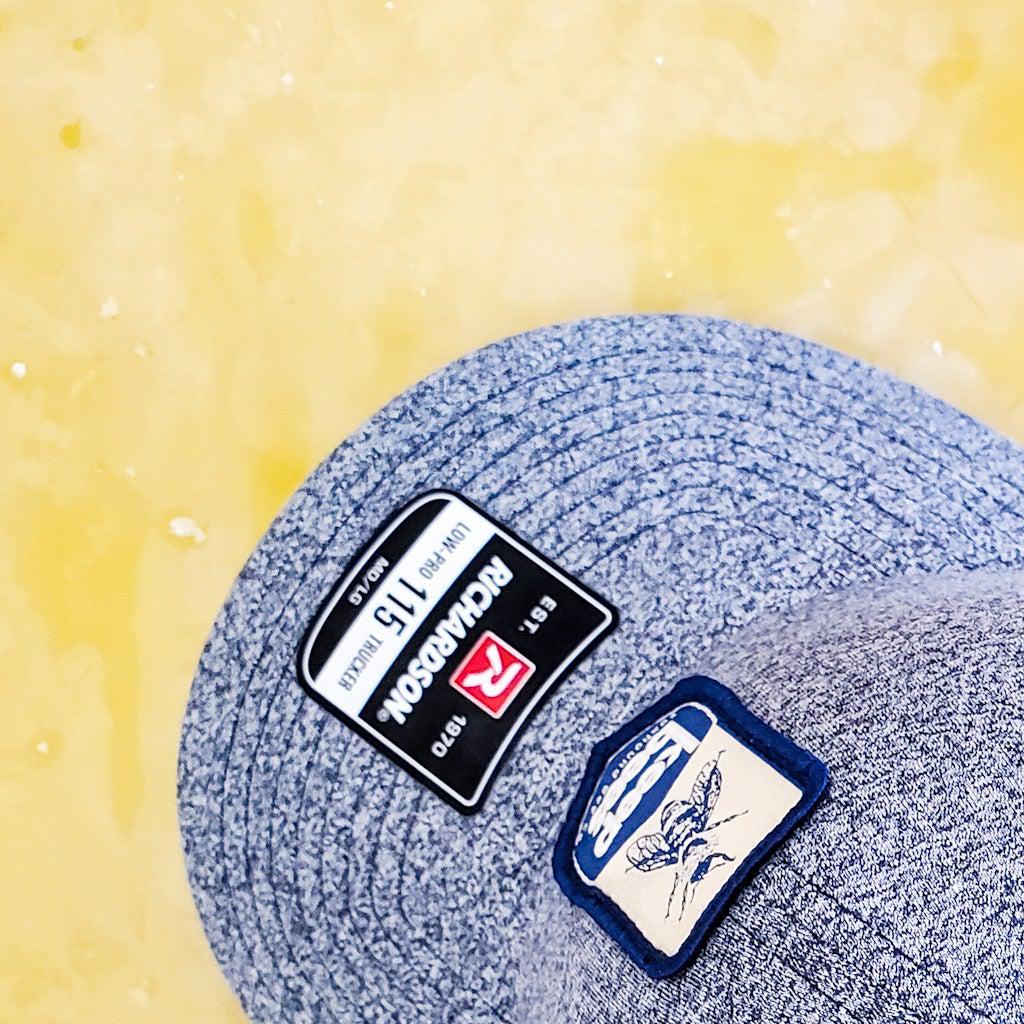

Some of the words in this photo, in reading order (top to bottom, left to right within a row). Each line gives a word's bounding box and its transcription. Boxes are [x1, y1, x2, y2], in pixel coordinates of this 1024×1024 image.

[419, 522, 471, 580] LOW-PRO
[350, 557, 389, 605] MD/LG
[374, 577, 427, 635] 115
[519, 595, 557, 634] EST.
[338, 634, 384, 691] TRUCKER
[462, 644, 521, 697] R
[431, 715, 466, 757] 1970
